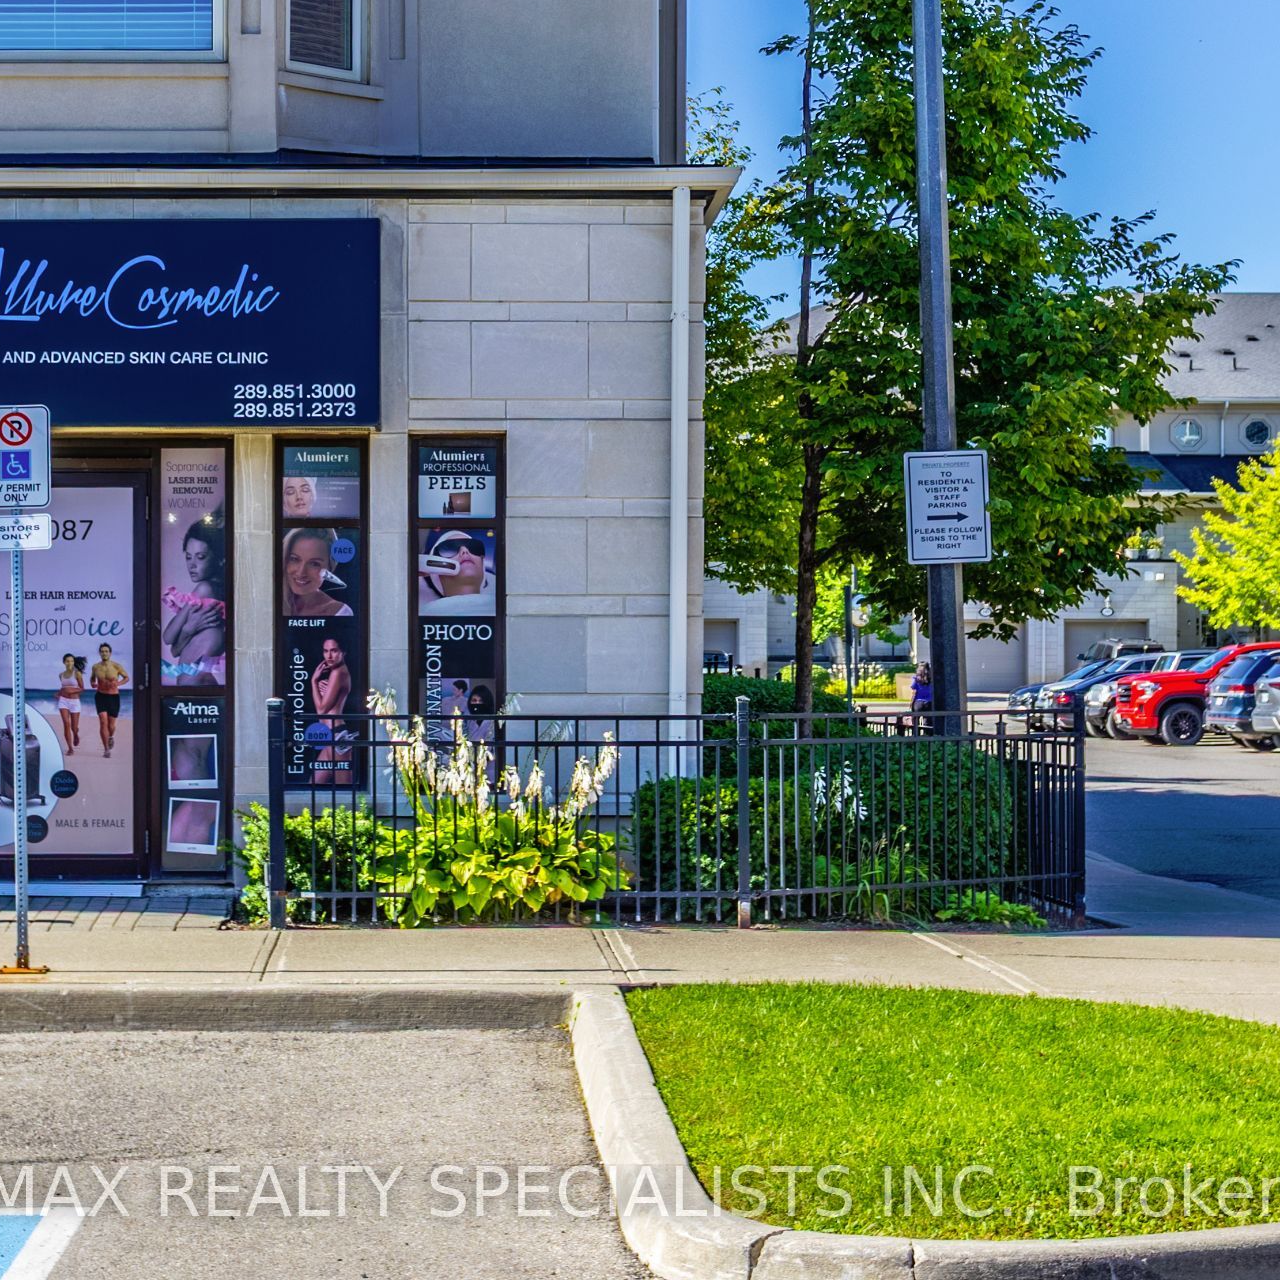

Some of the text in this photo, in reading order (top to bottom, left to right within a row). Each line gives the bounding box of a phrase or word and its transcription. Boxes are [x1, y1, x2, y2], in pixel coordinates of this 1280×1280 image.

[105, 255, 280, 329] Cosmedic
[2, 352, 36, 365] AND
[39, 352, 126, 365] ADVANCED
[129, 352, 166, 365] SKIN
[170, 352, 214, 365] CARE
[216, 352, 269, 365] CLINIC
[233, 384, 356, 399] 289.851.3000
[233, 402, 356, 418] 289.851.2373
[423, 463, 491, 472] PROFESSIONAL
[168, 476, 218, 484] LASER HAIR
[428, 476, 486, 490] PEELS
[917, 478, 976, 486] RESIDENTIAL
[6, 483, 41, 493] PERMIT
[172, 486, 214, 495] REMOVAL
[3, 493, 29, 502] ONLY
[168, 498, 205, 509] WOMEN
[50, 519, 94, 541] 087
[334, 546, 353, 555] FACE
[5, 591, 116, 600] LER HAIR REMOVAL
[288, 619, 326, 627] FACE LIFT
[423, 624, 492, 641] PHOTO
[170, 702, 220, 715] Alma
[307, 732, 329, 740] BODY
[309, 761, 349, 770] CELLUITE
[55, 819, 126, 828] MALE & FEMALE
